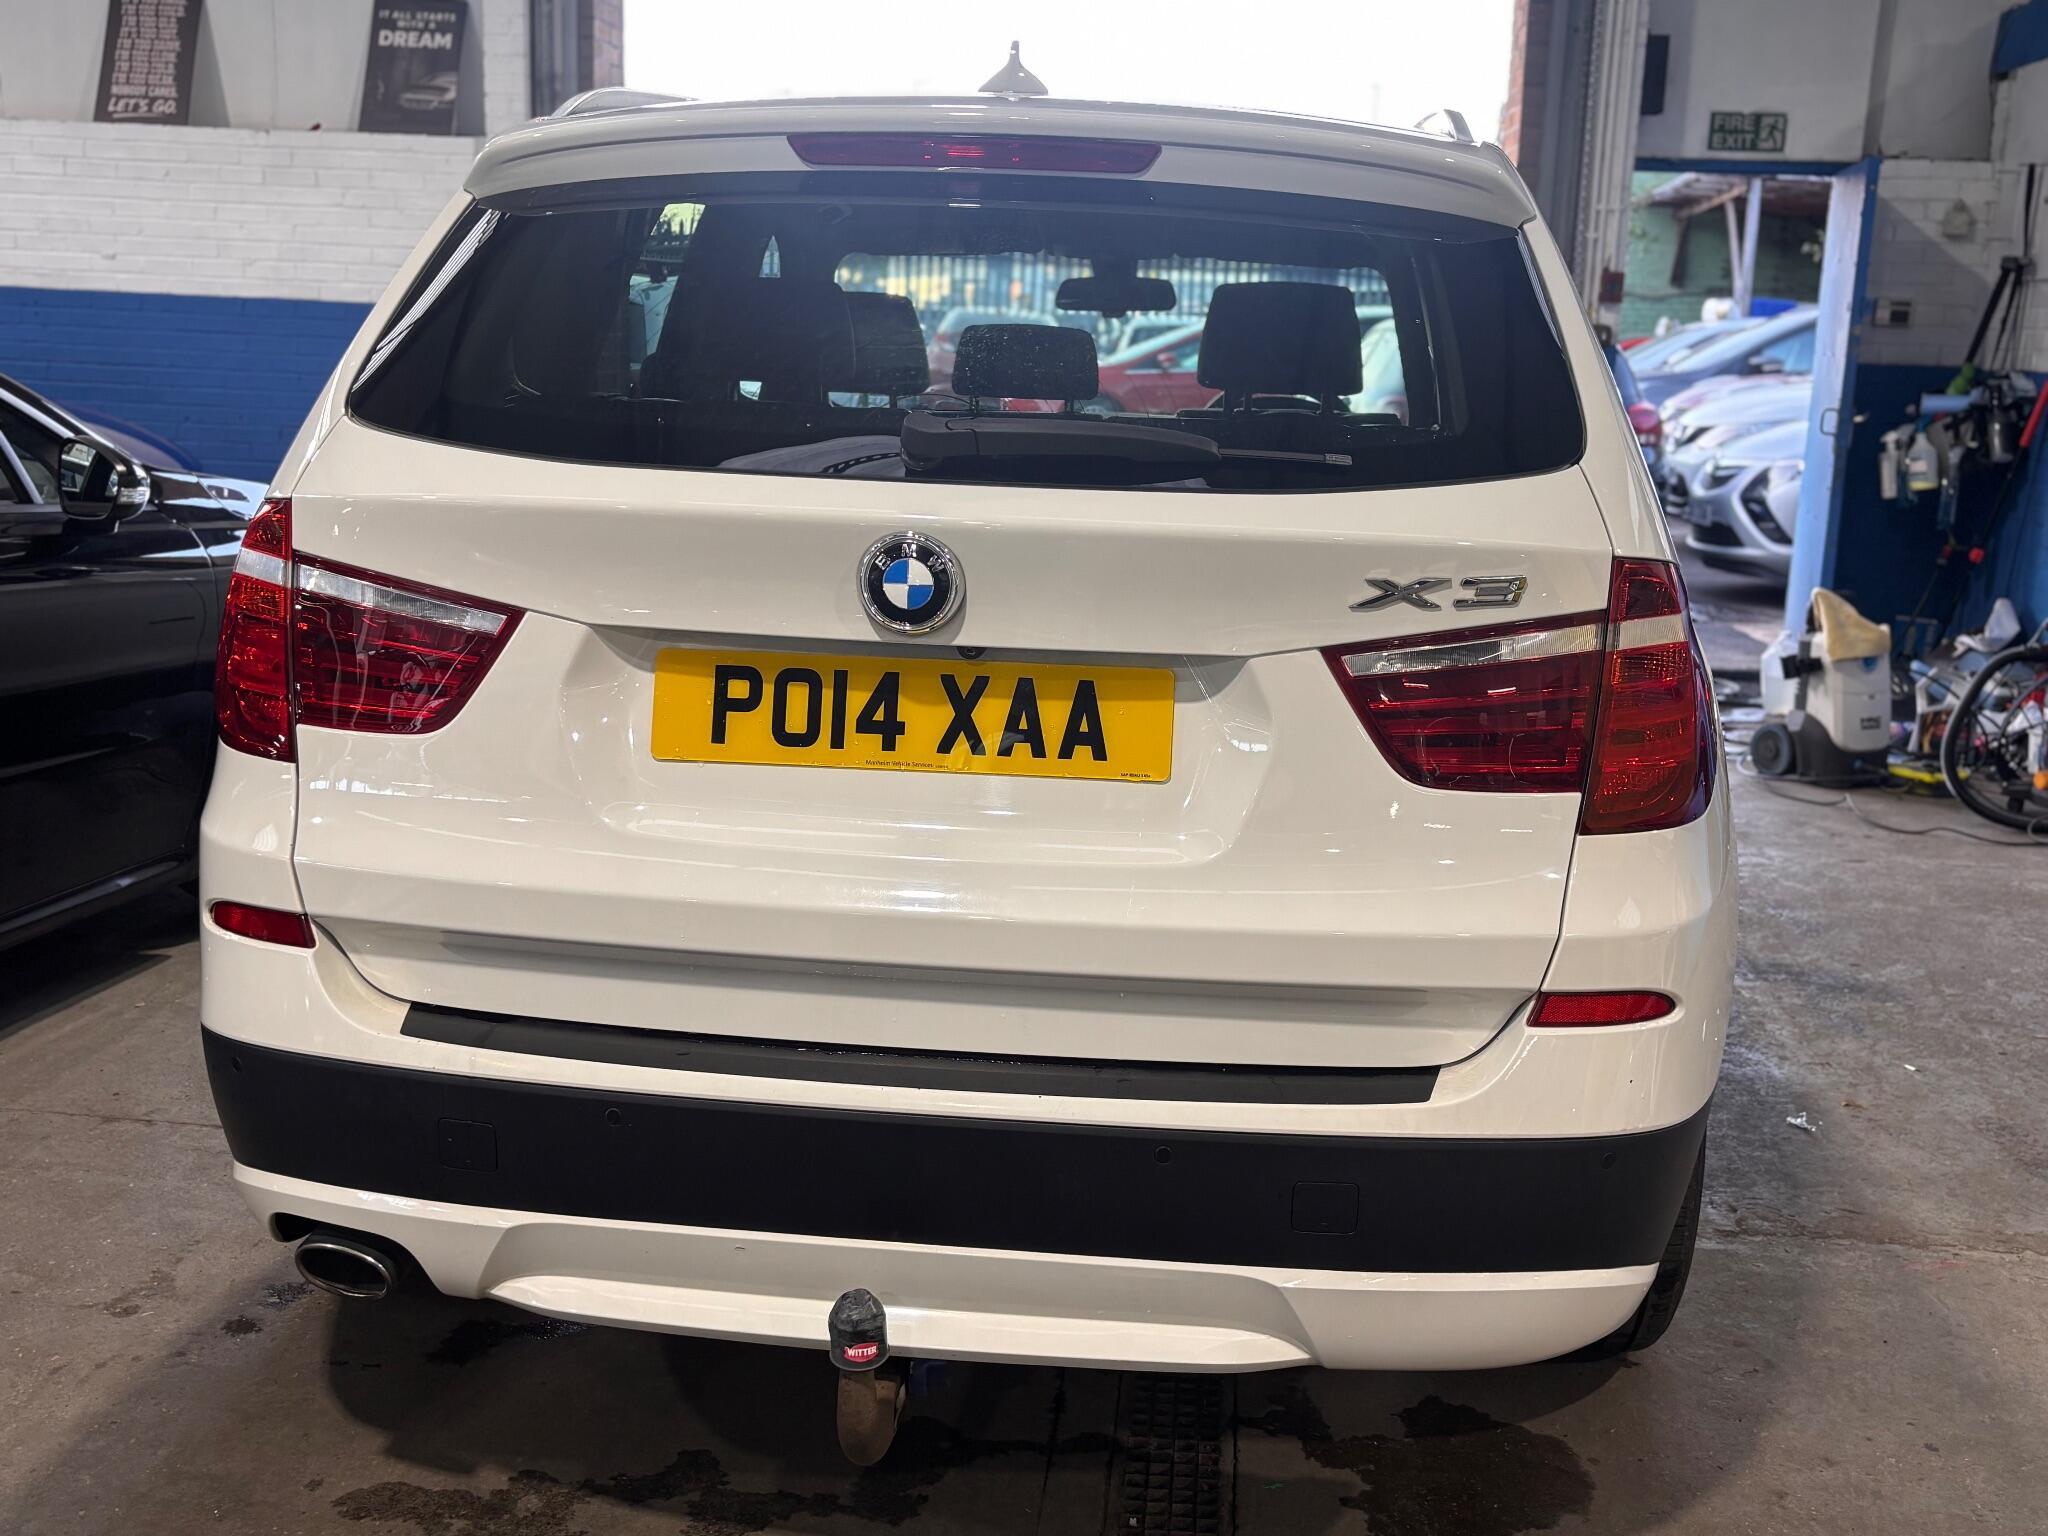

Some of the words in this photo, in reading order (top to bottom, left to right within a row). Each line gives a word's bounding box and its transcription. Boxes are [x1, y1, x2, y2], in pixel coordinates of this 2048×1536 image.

[378, 29, 454, 50] DREAM
[107, 96, 149, 113] LET'S
[1713, 114, 1756, 131] FIRE
[1711, 132, 1756, 150] EXIT
[875, 543, 945, 572] BMW
[711, 665, 906, 752] PO14
[936, 673, 1108, 762] XAA
[845, 1345, 877, 1357] WITTER
